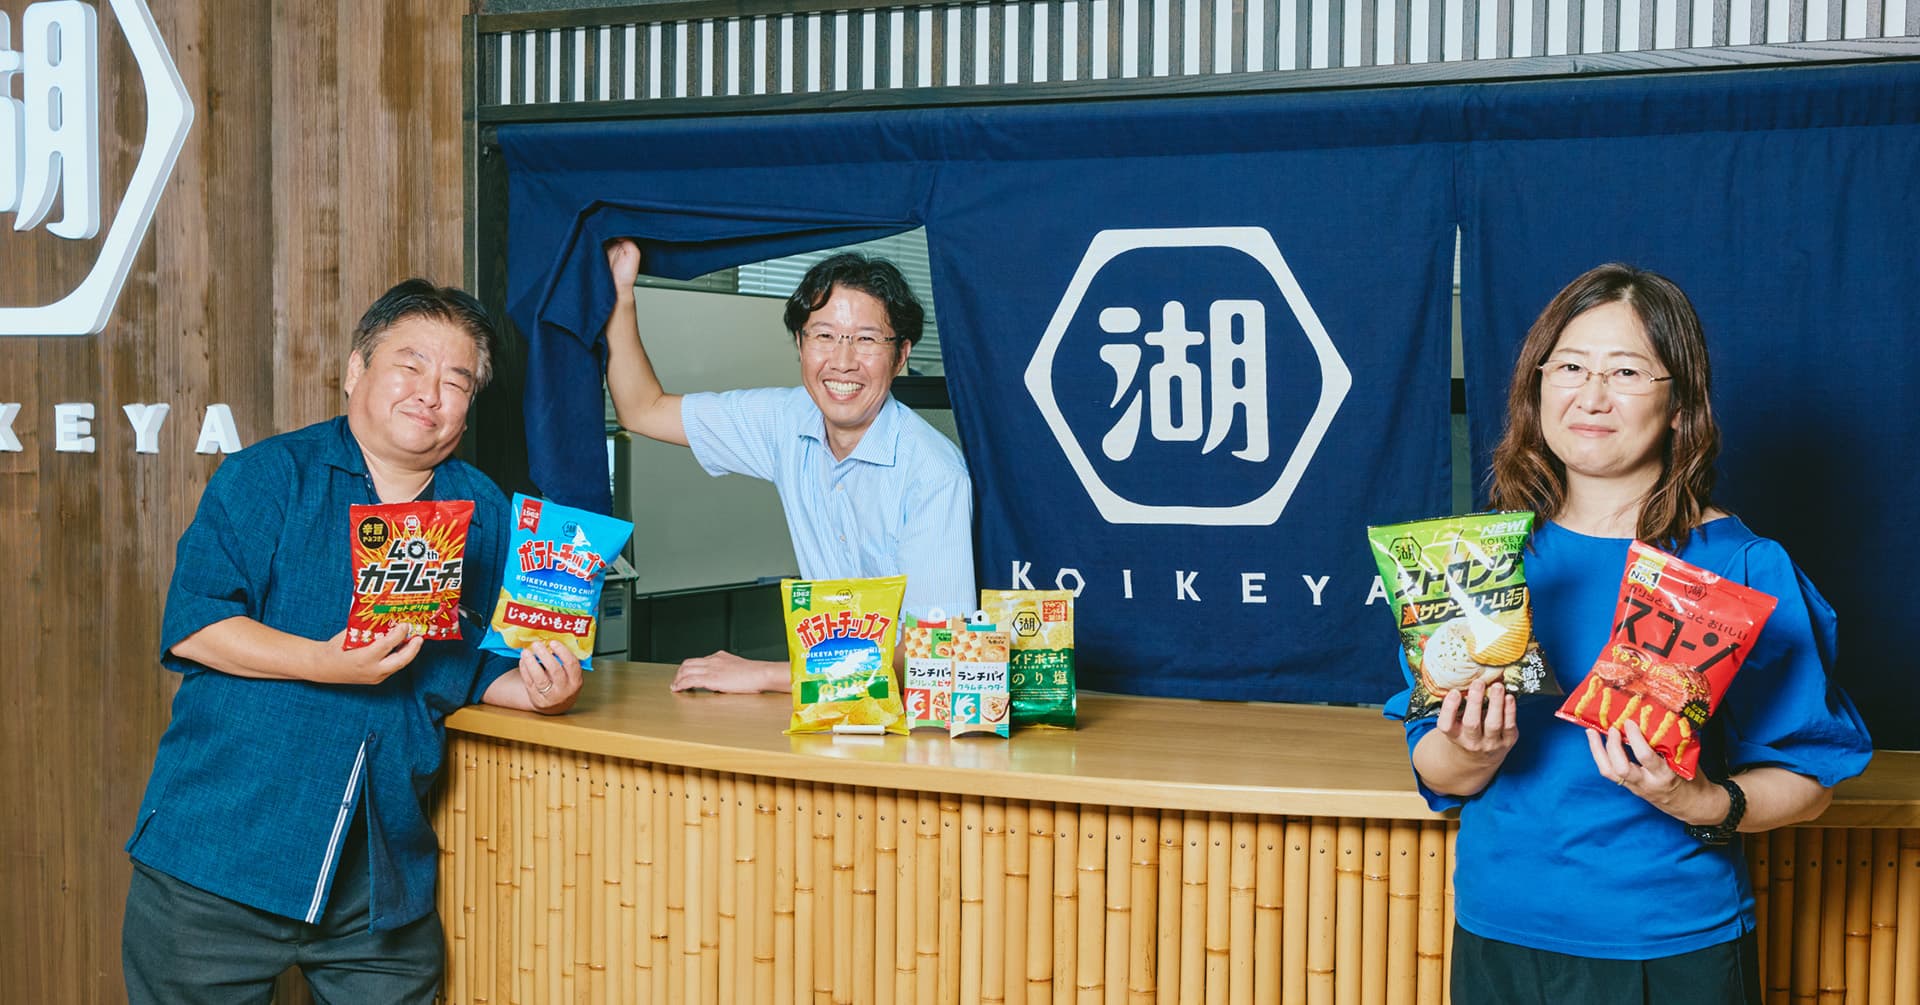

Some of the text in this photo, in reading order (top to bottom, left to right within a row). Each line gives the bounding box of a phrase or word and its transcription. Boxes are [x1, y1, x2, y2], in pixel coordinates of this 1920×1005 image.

[1098, 299, 1270, 462] 湖
[362, 523, 384, 535] 辛旨
[1481, 519, 1527, 537] NEW!
[388, 539, 439, 560] 40th
[1395, 543, 1415, 561] 湖
[358, 559, 462, 593] カラムーチョ
[516, 575, 547, 586] KOIKEYA
[549, 583, 577, 593] POTATO
[1011, 561, 1391, 606] KOIKEYA
[507, 606, 589, 634] じゃがいもと塩
[796, 610, 892, 648] ポテトチップス
[1615, 596, 1742, 673] スコーン
[957, 671, 1004, 681] ランチパイ
